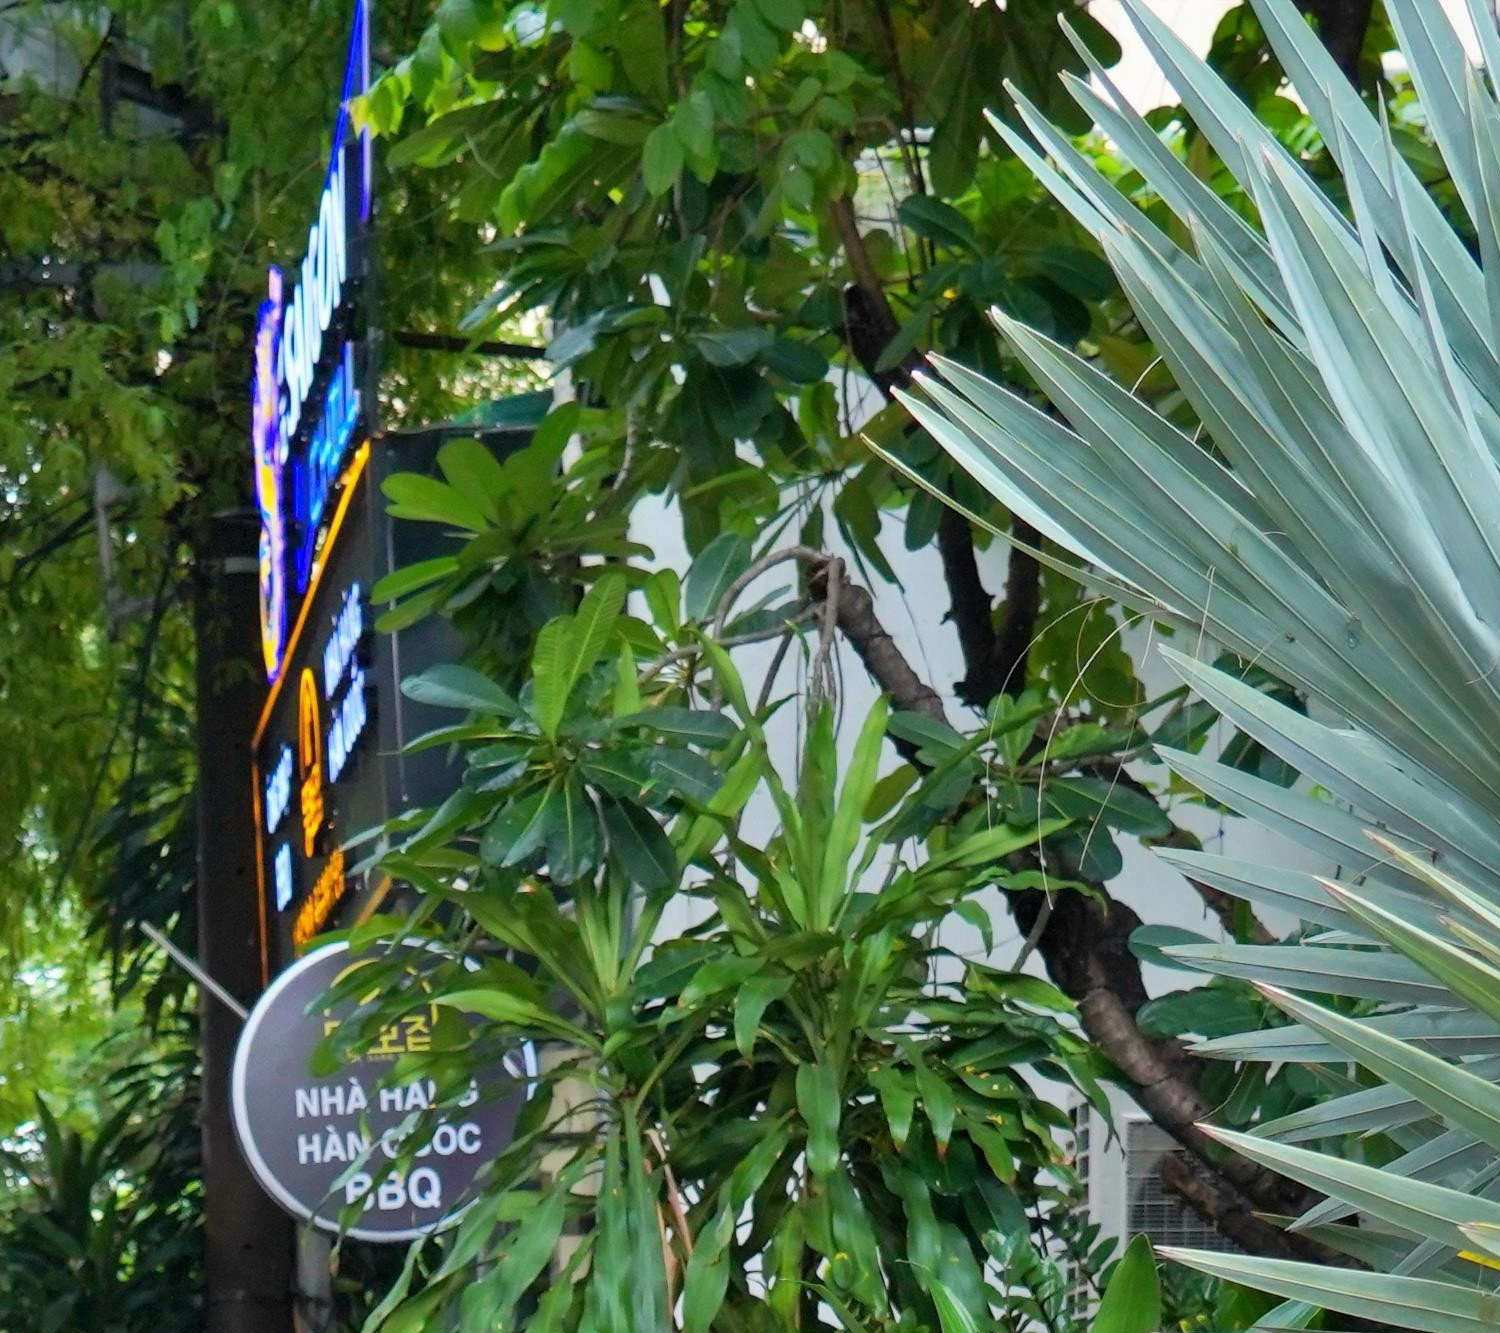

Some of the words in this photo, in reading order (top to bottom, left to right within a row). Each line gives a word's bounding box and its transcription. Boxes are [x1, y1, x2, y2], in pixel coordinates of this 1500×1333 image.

[284, 145, 347, 437] SAIGON
[295, 1076, 368, 1118] NHÀ
[297, 1124, 371, 1164] HÀN
[345, 1166, 441, 1211] BBQ
